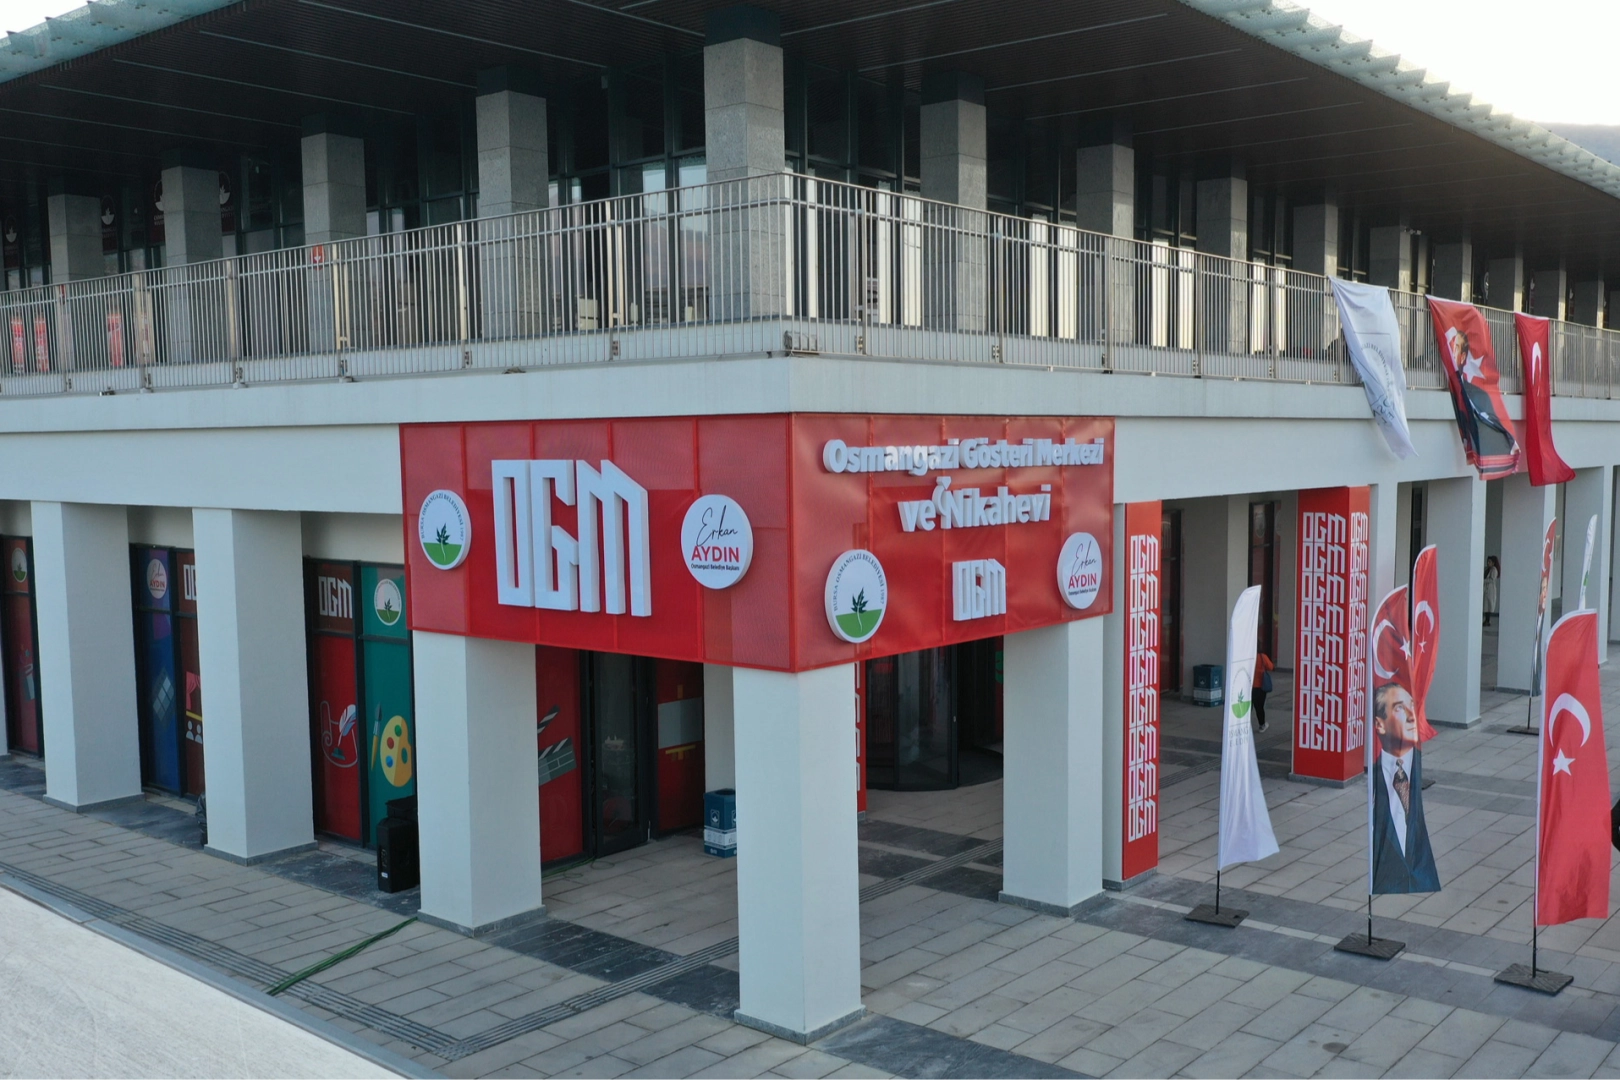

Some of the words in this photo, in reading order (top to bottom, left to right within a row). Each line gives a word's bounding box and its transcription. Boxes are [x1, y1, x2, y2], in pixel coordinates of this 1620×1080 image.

[823, 438, 959, 476] Osmangazi
[960, 437, 1033, 469] Gösteri
[1032, 437, 1105, 466] Merkezi
[897, 499, 937, 532] ve
[940, 483, 1051, 529] Nikahevi
[491, 459, 652, 617] OGM
[696, 504, 738, 547] Erkan
[1303, 512, 1346, 544] OGM
[691, 545, 740, 563] AYDIN
[1302, 542, 1346, 574] OGM
[318, 576, 353, 619] OGM
[952, 558, 1006, 621] OGM
[1068, 572, 1097, 590] AYDIN
[1301, 571, 1345, 604] OGM
[1301, 601, 1344, 634] OGM
[1300, 631, 1344, 664] OGM
[1300, 660, 1343, 694] OGM
[1299, 690, 1342, 723] OGM
[1298, 719, 1342, 753] OGM
